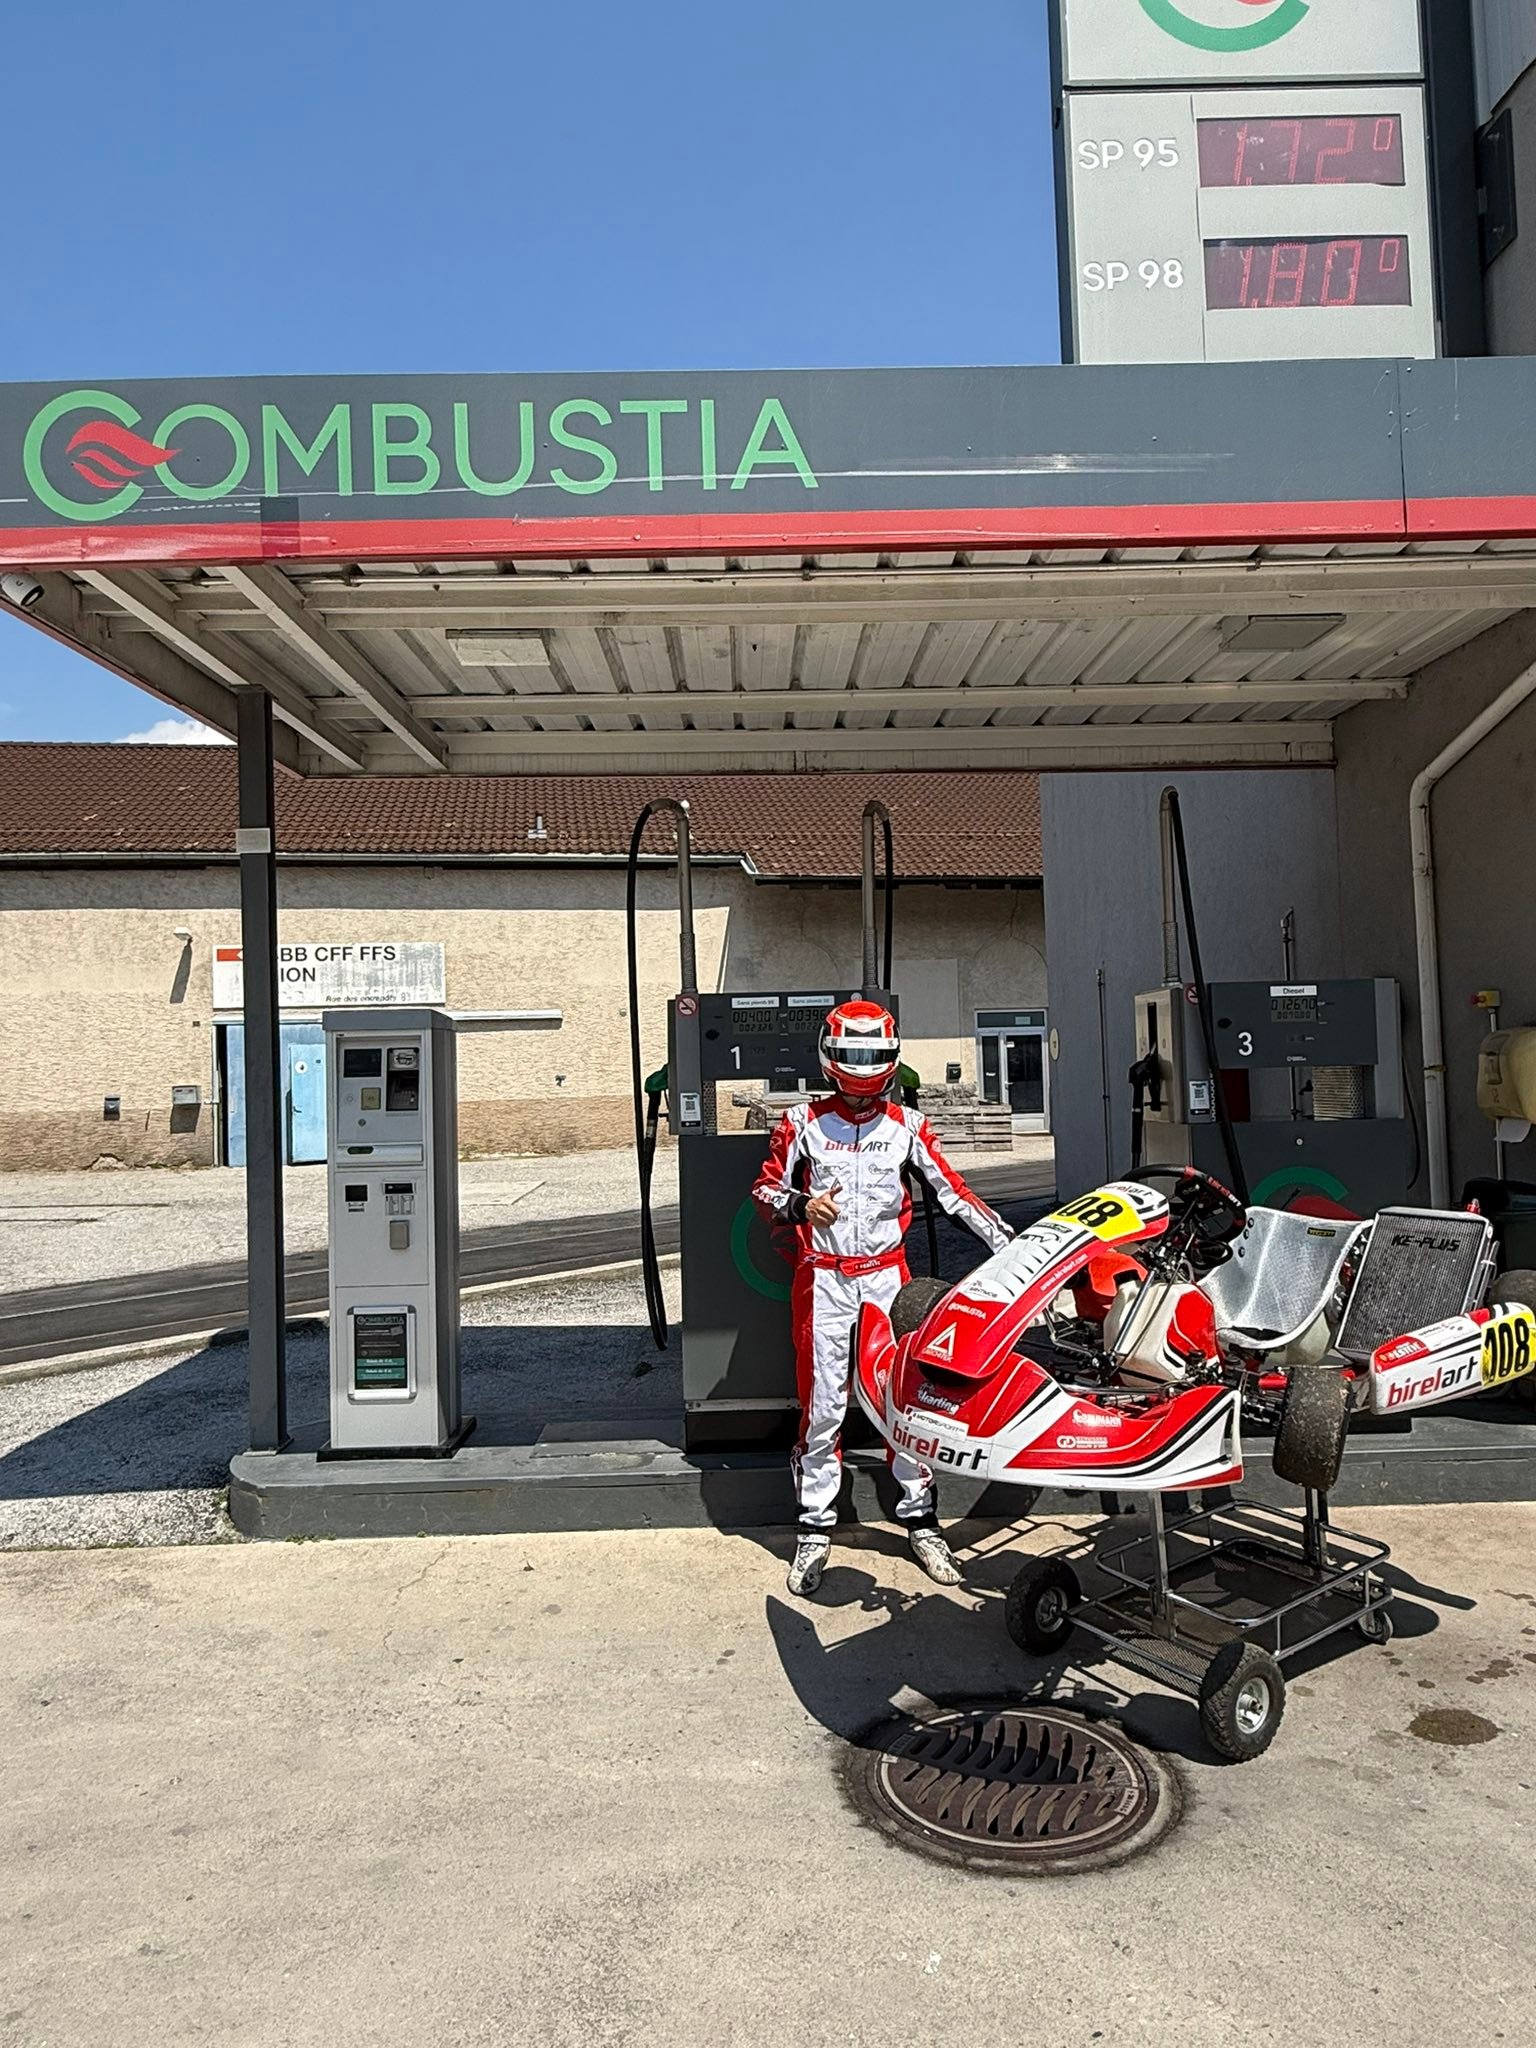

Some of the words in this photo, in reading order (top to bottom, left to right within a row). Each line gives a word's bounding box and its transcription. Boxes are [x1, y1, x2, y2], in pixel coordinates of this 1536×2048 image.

[1078, 139, 1124, 170] SP
[1133, 138, 1179, 168] 95
[1083, 261, 1129, 292] SP
[1137, 258, 1184, 290] 98
[23, 389, 820, 522] COMBUSTIA
[278, 947, 307, 962] BB
[315, 947, 353, 961] CFF
[360, 946, 396, 961] FFS
[280, 967, 316, 982] ION
[730, 1046, 741, 1070] 1
[1237, 1031, 1254, 1057] 3
[1057, 1196, 1123, 1227] 08
[1484, 1317, 1530, 1383] 108
[1386, 1356, 1478, 1408] birelart
[893, 1421, 988, 1471] birelart
